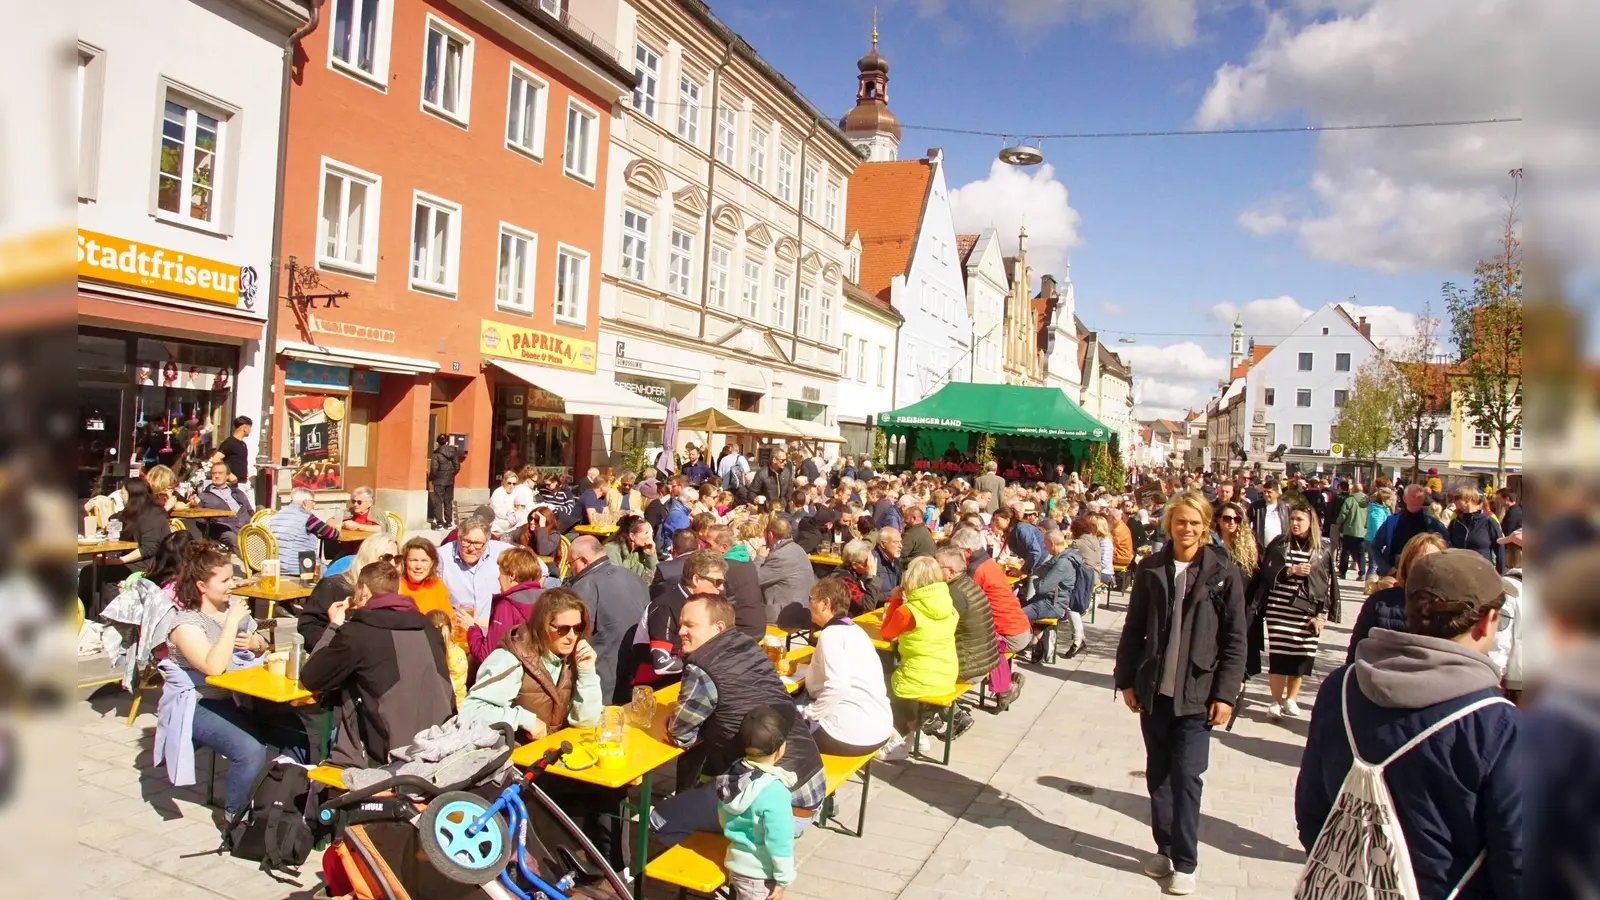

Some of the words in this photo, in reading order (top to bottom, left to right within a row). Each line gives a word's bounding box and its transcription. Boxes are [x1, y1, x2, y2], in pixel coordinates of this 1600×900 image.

[512, 333, 572, 359] PAPRIKA
[896, 416, 940, 425] FREISINGER
[940, 418, 962, 427] LAND
[360, 803, 384, 811] THULE
